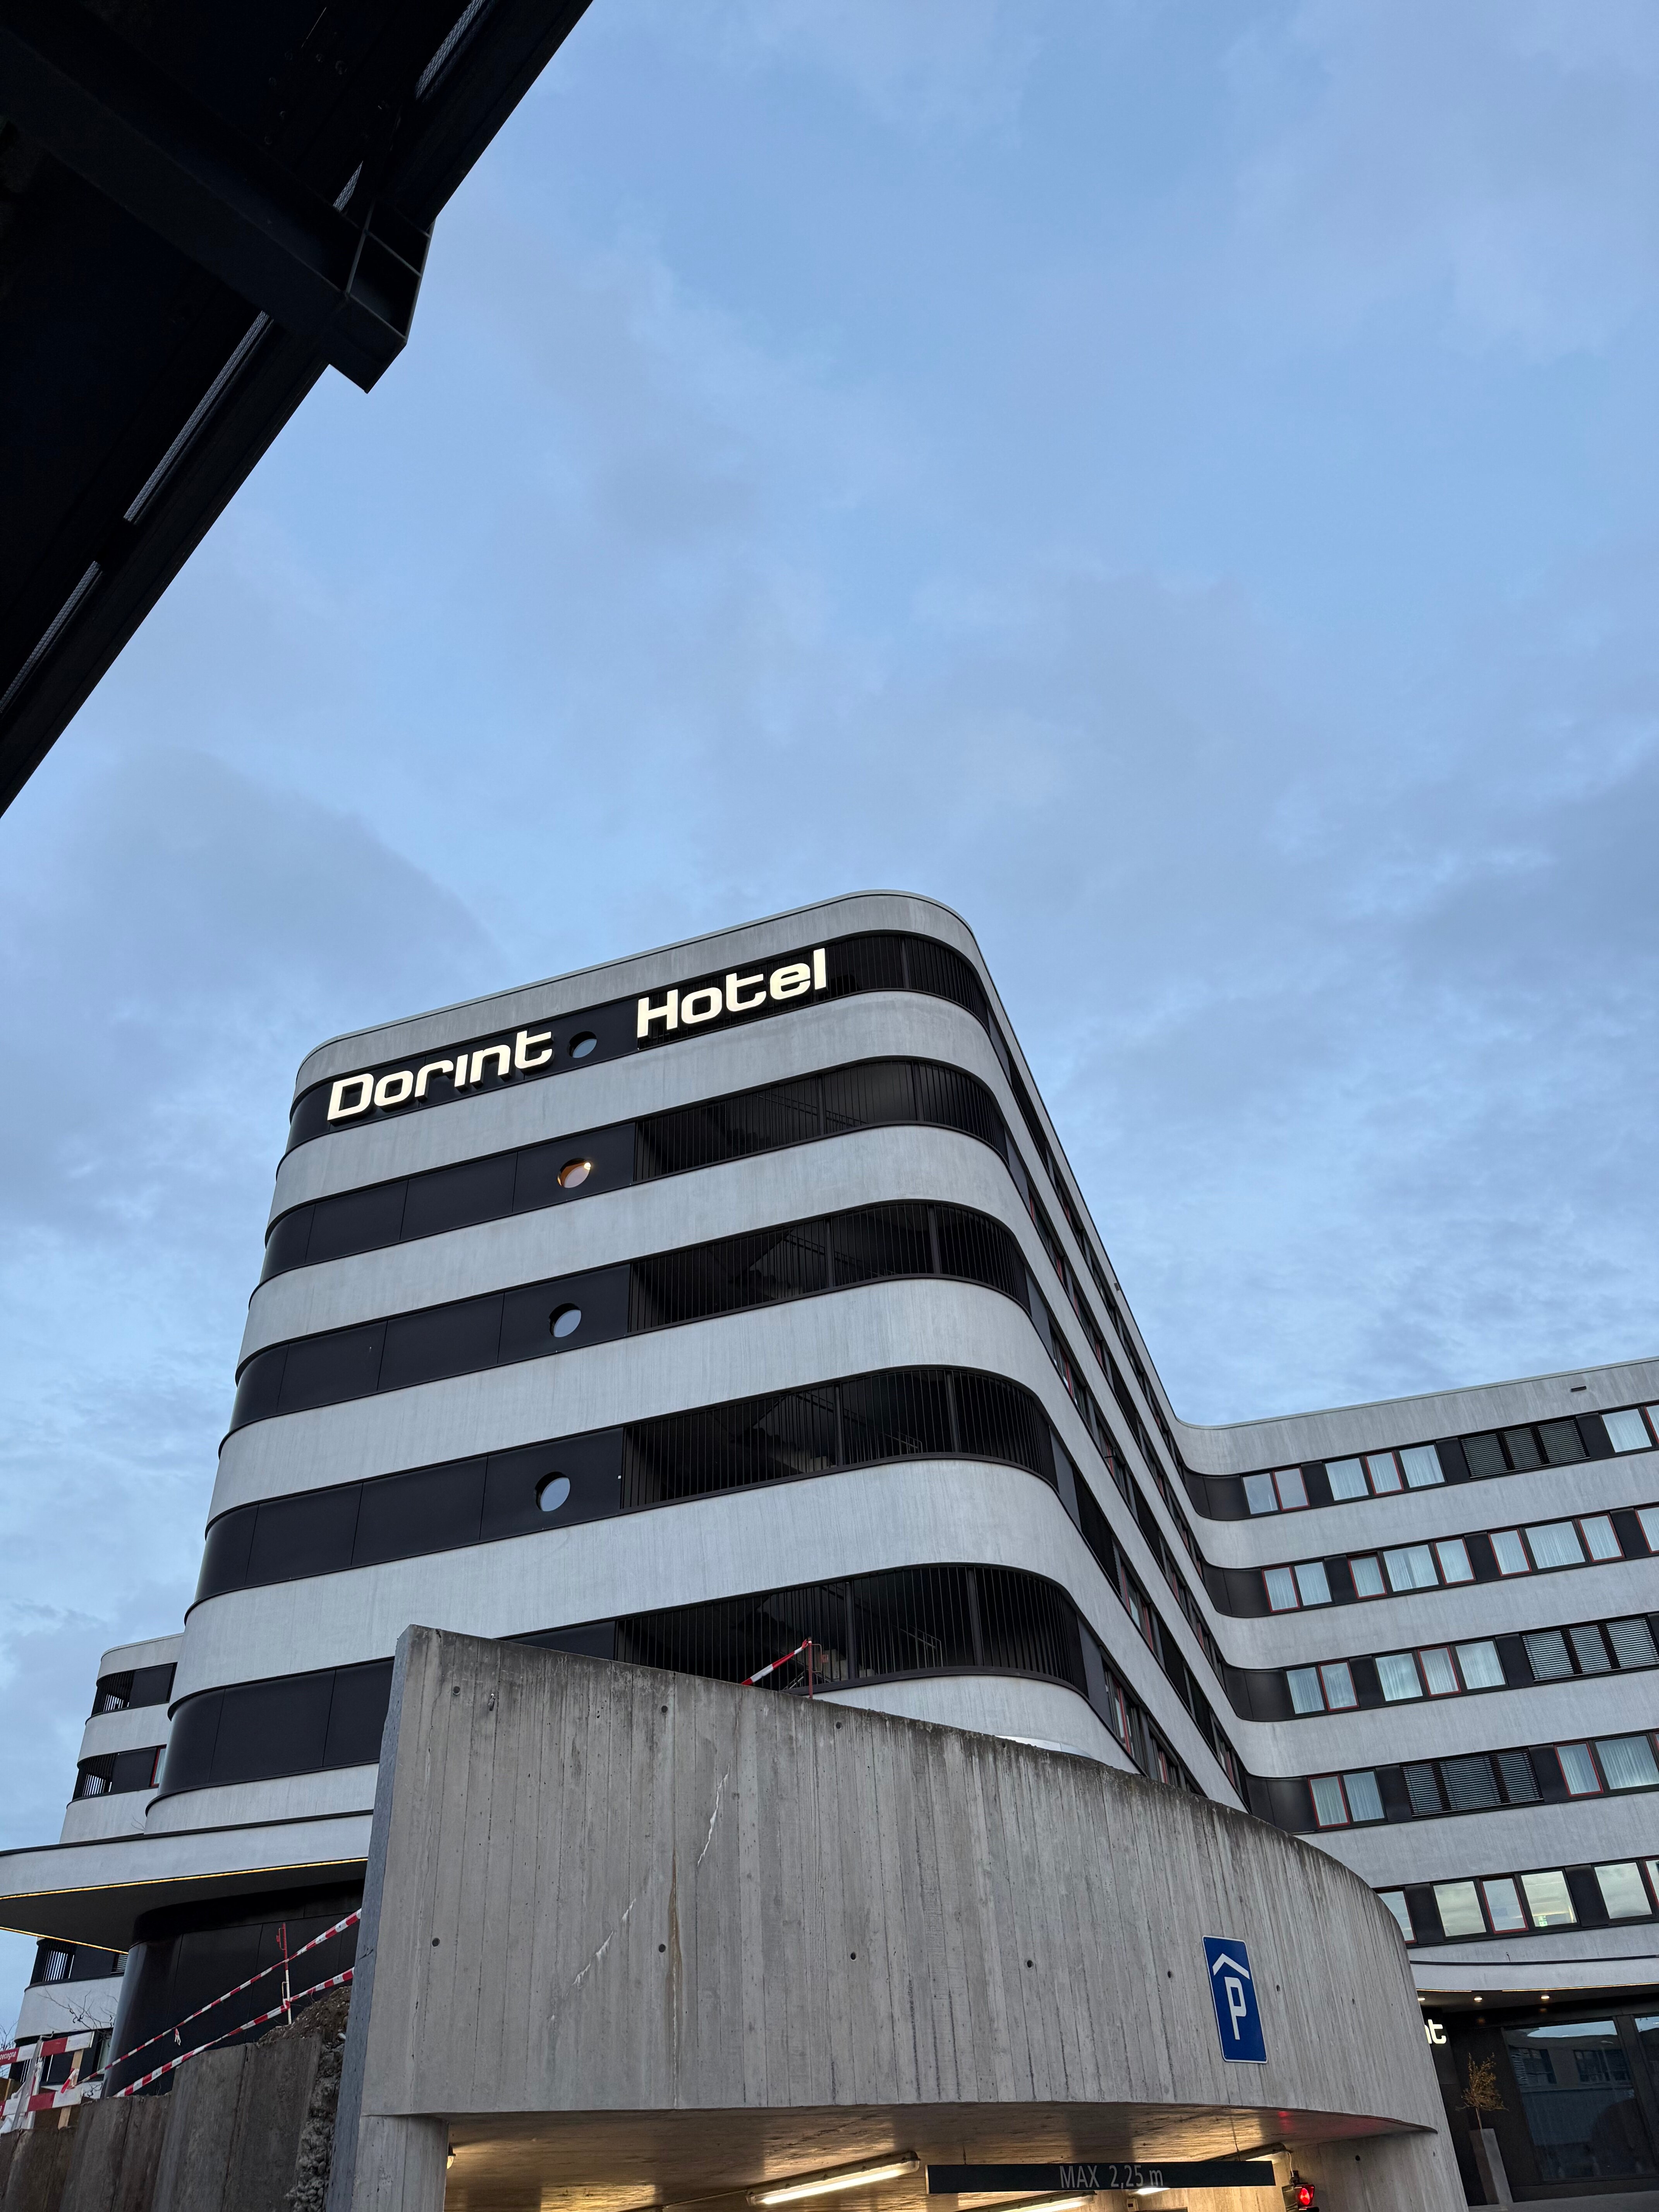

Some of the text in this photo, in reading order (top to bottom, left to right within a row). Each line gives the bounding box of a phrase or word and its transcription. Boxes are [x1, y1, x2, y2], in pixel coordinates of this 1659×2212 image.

[326, 947, 827, 1122] Dorint Hotel
[1224, 1976, 1247, 2040] P
[1059, 2164, 1164, 2189] MAX 2,25 m
